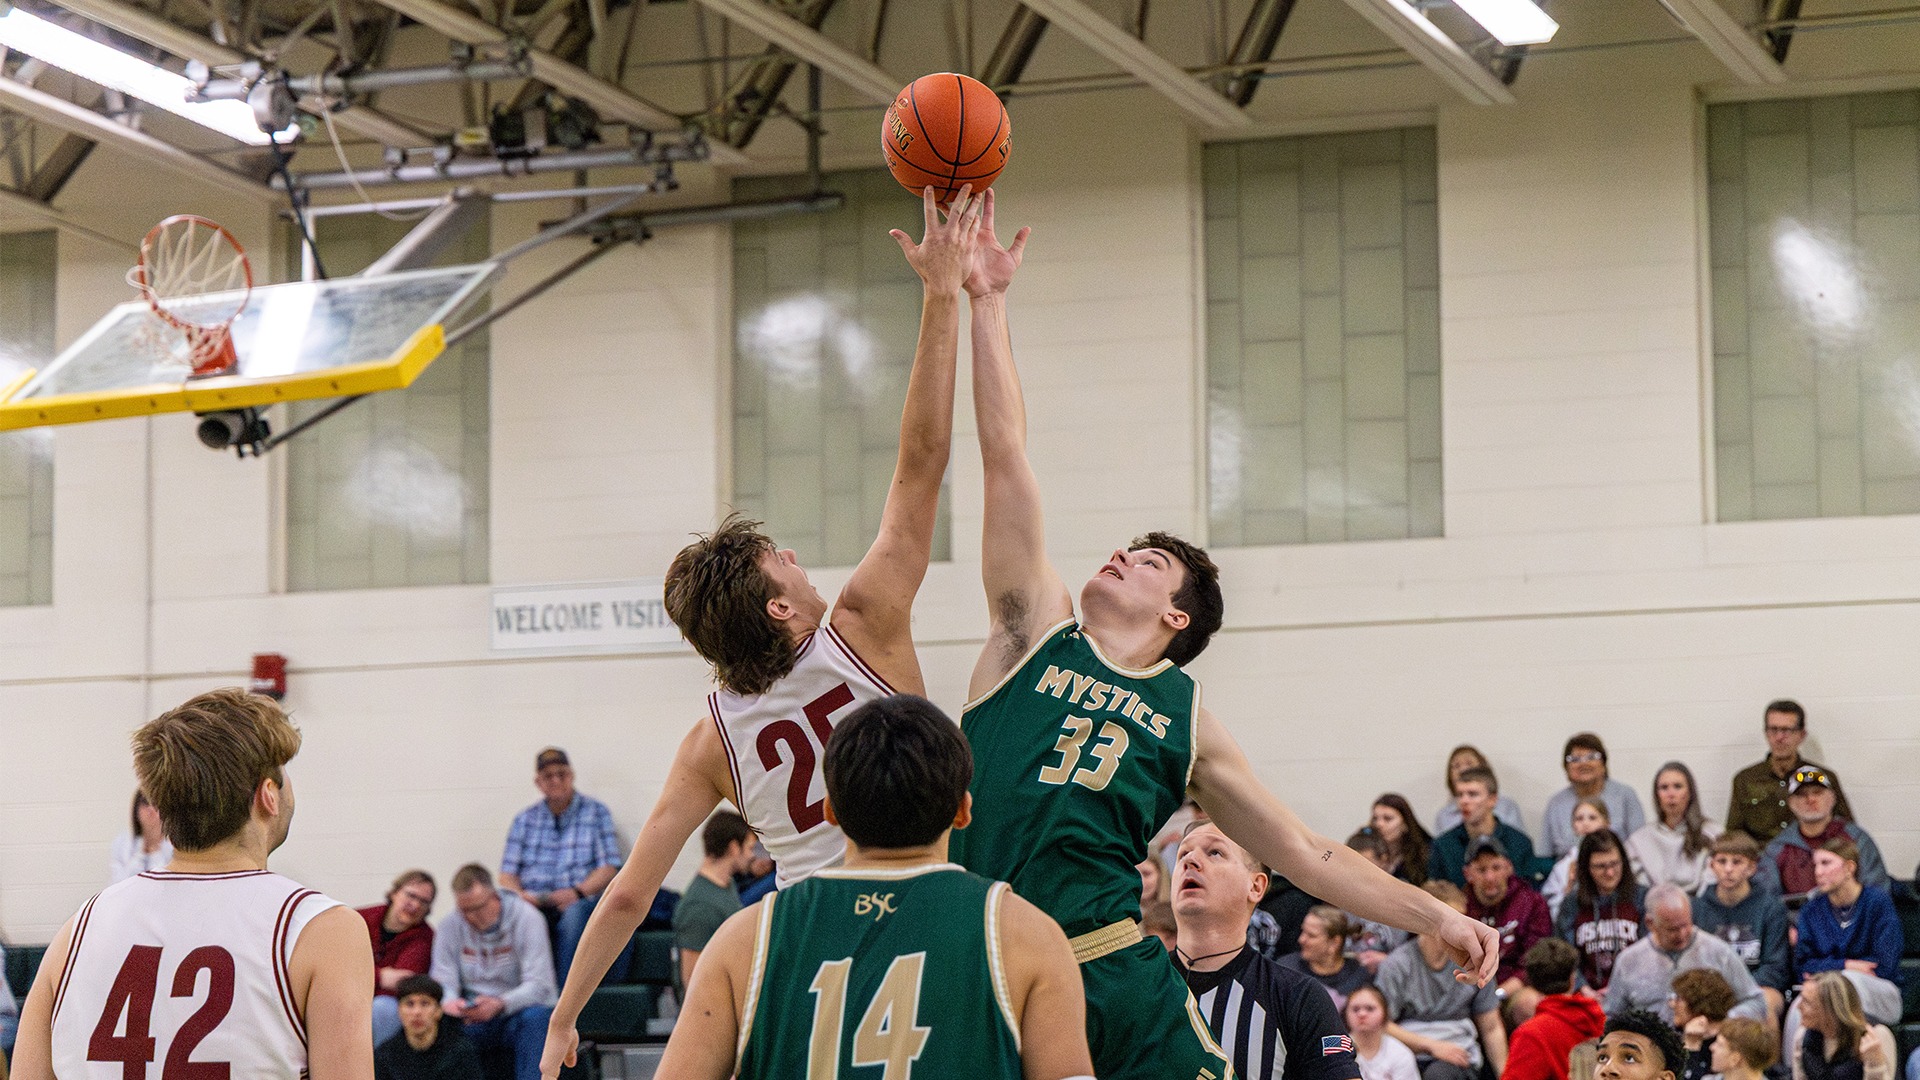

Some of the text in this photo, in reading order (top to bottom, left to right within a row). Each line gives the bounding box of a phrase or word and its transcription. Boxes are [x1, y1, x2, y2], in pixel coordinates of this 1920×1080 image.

[495, 602, 604, 634] WELCOME
[1034, 664, 1172, 740] MYSTICS
[1037, 714, 1130, 792] 33
[854, 891, 898, 923] BSC
[86, 943, 236, 1080] 42
[805, 950, 932, 1080] 14
